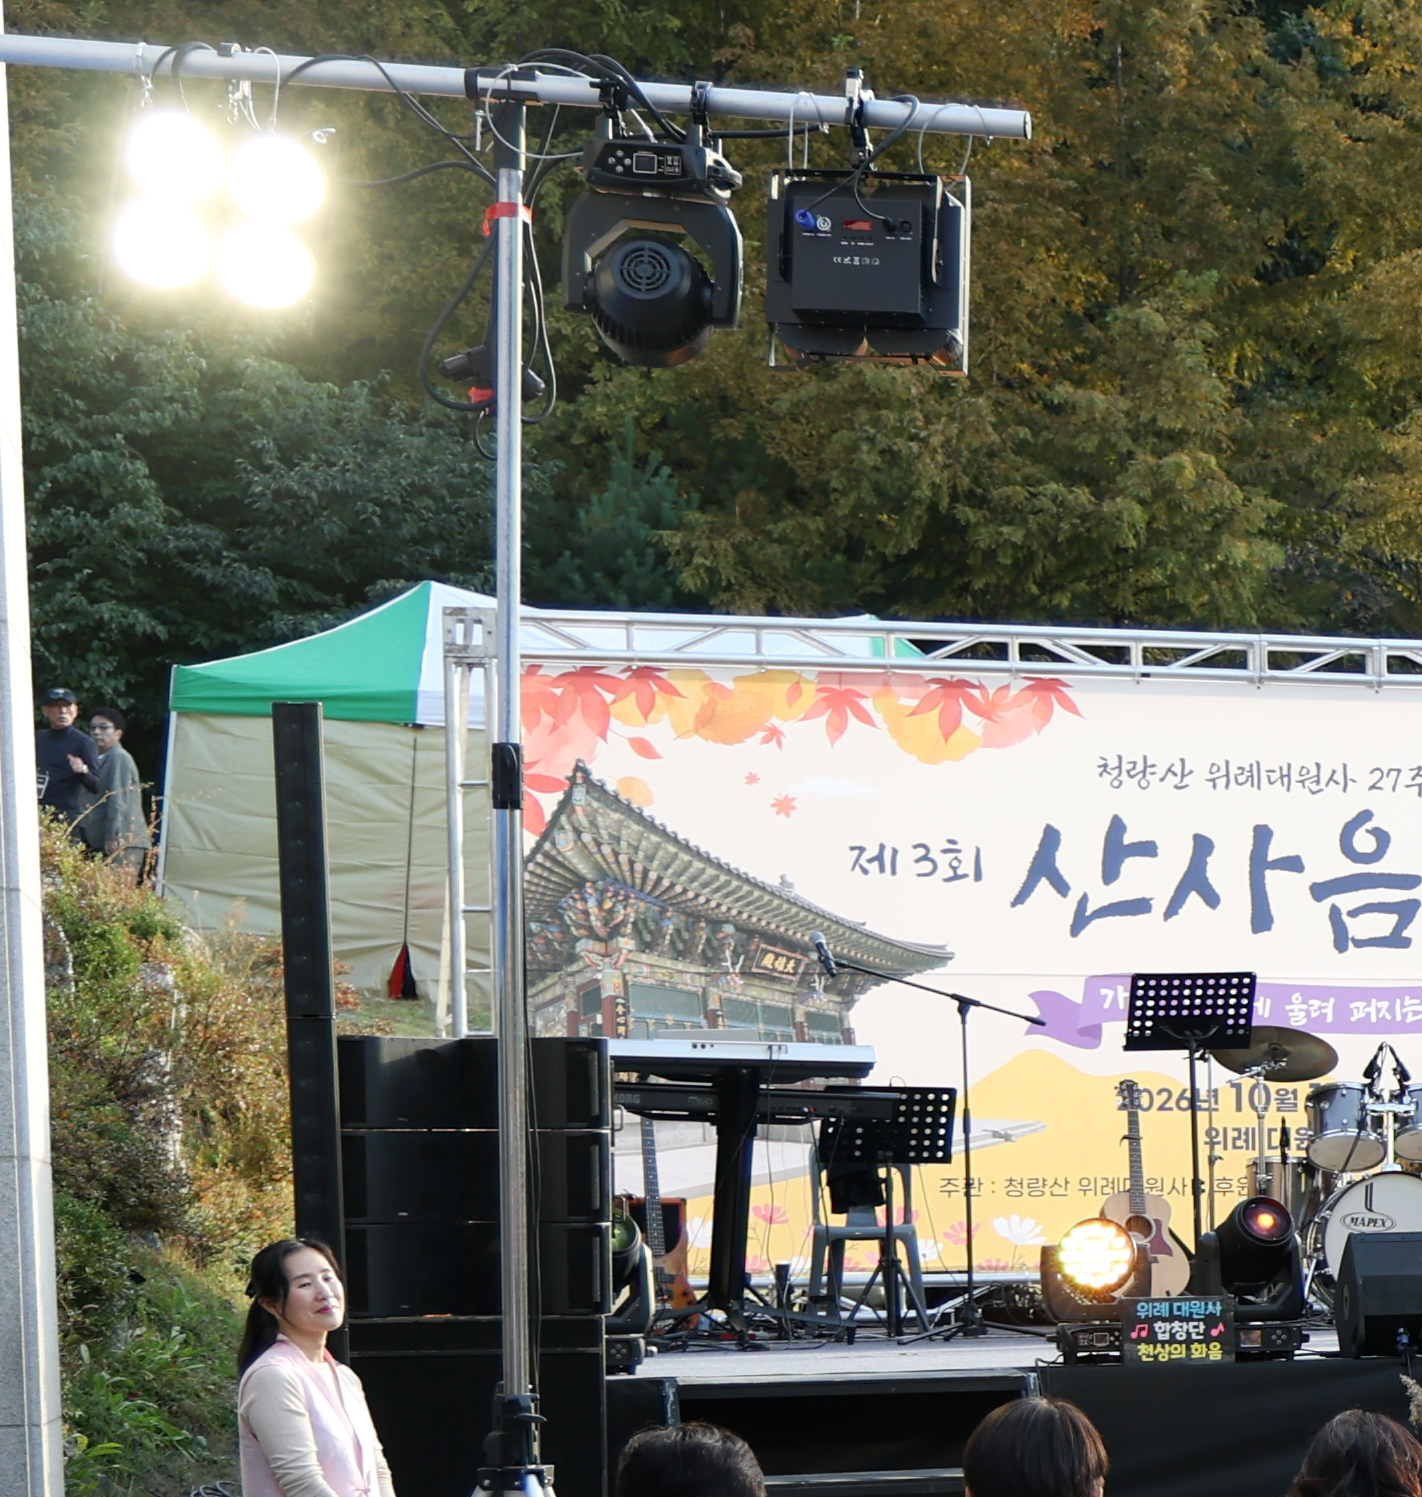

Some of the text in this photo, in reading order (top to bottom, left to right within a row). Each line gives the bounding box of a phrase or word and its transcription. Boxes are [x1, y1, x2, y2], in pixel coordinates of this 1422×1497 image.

[1097, 754, 1193, 791] 청량산
[1204, 759, 1357, 794] 위례대원사
[849, 842, 899, 877] 제
[911, 838, 983, 883] 3회
[1284, 992, 1335, 1026] 울려
[1116, 1086, 1220, 1112] 026년
[1204, 1127, 1256, 1151] 위례
[1003, 1176, 1070, 1198] 청량산
[1350, 1216, 1386, 1228] MAPEX
[1136, 1300, 1222, 1319] 위례 대원사
[1153, 1320, 1206, 1341] 합창단
[1137, 1341, 1224, 1362] 천상의 화음
